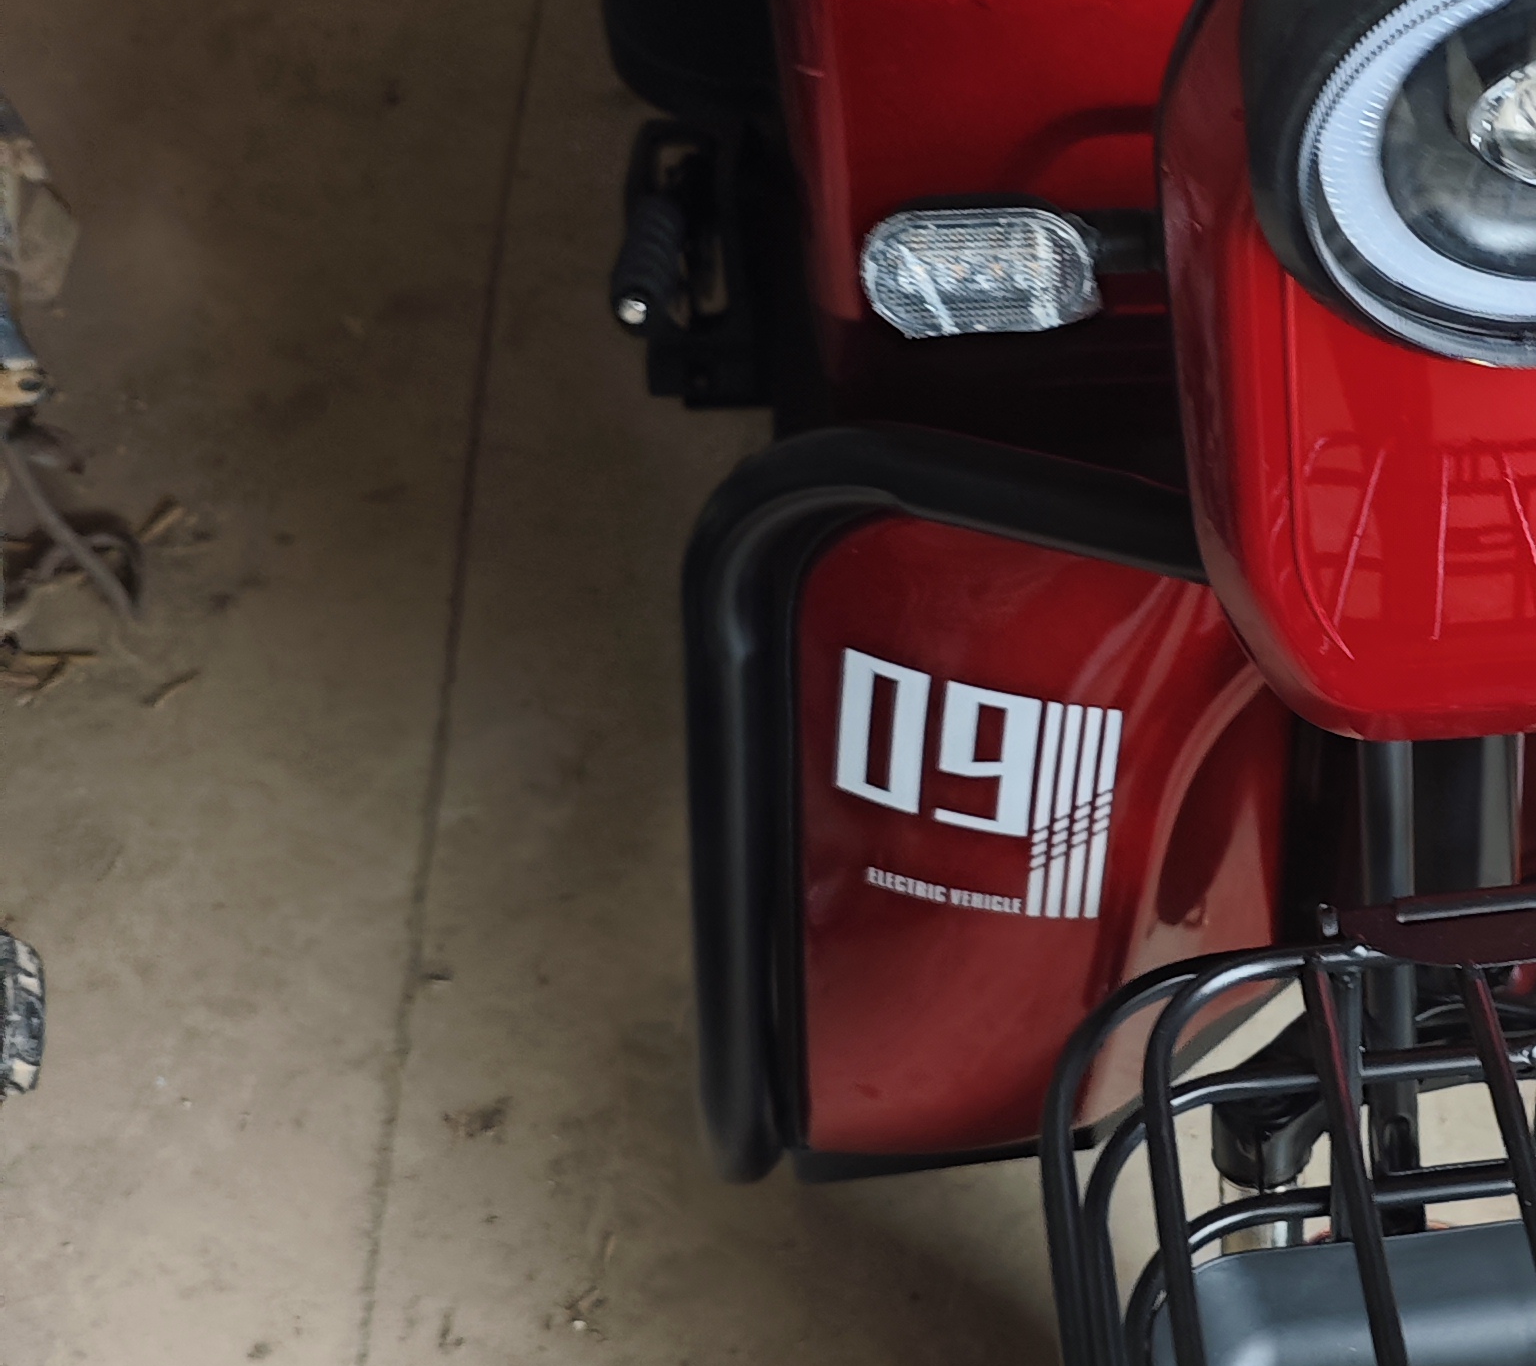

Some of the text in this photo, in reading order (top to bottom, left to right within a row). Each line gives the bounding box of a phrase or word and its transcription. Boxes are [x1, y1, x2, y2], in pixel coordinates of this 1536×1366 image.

[834, 647, 1043, 837] 09
[867, 866, 1022, 914] ELECTRIC VEHICLE
